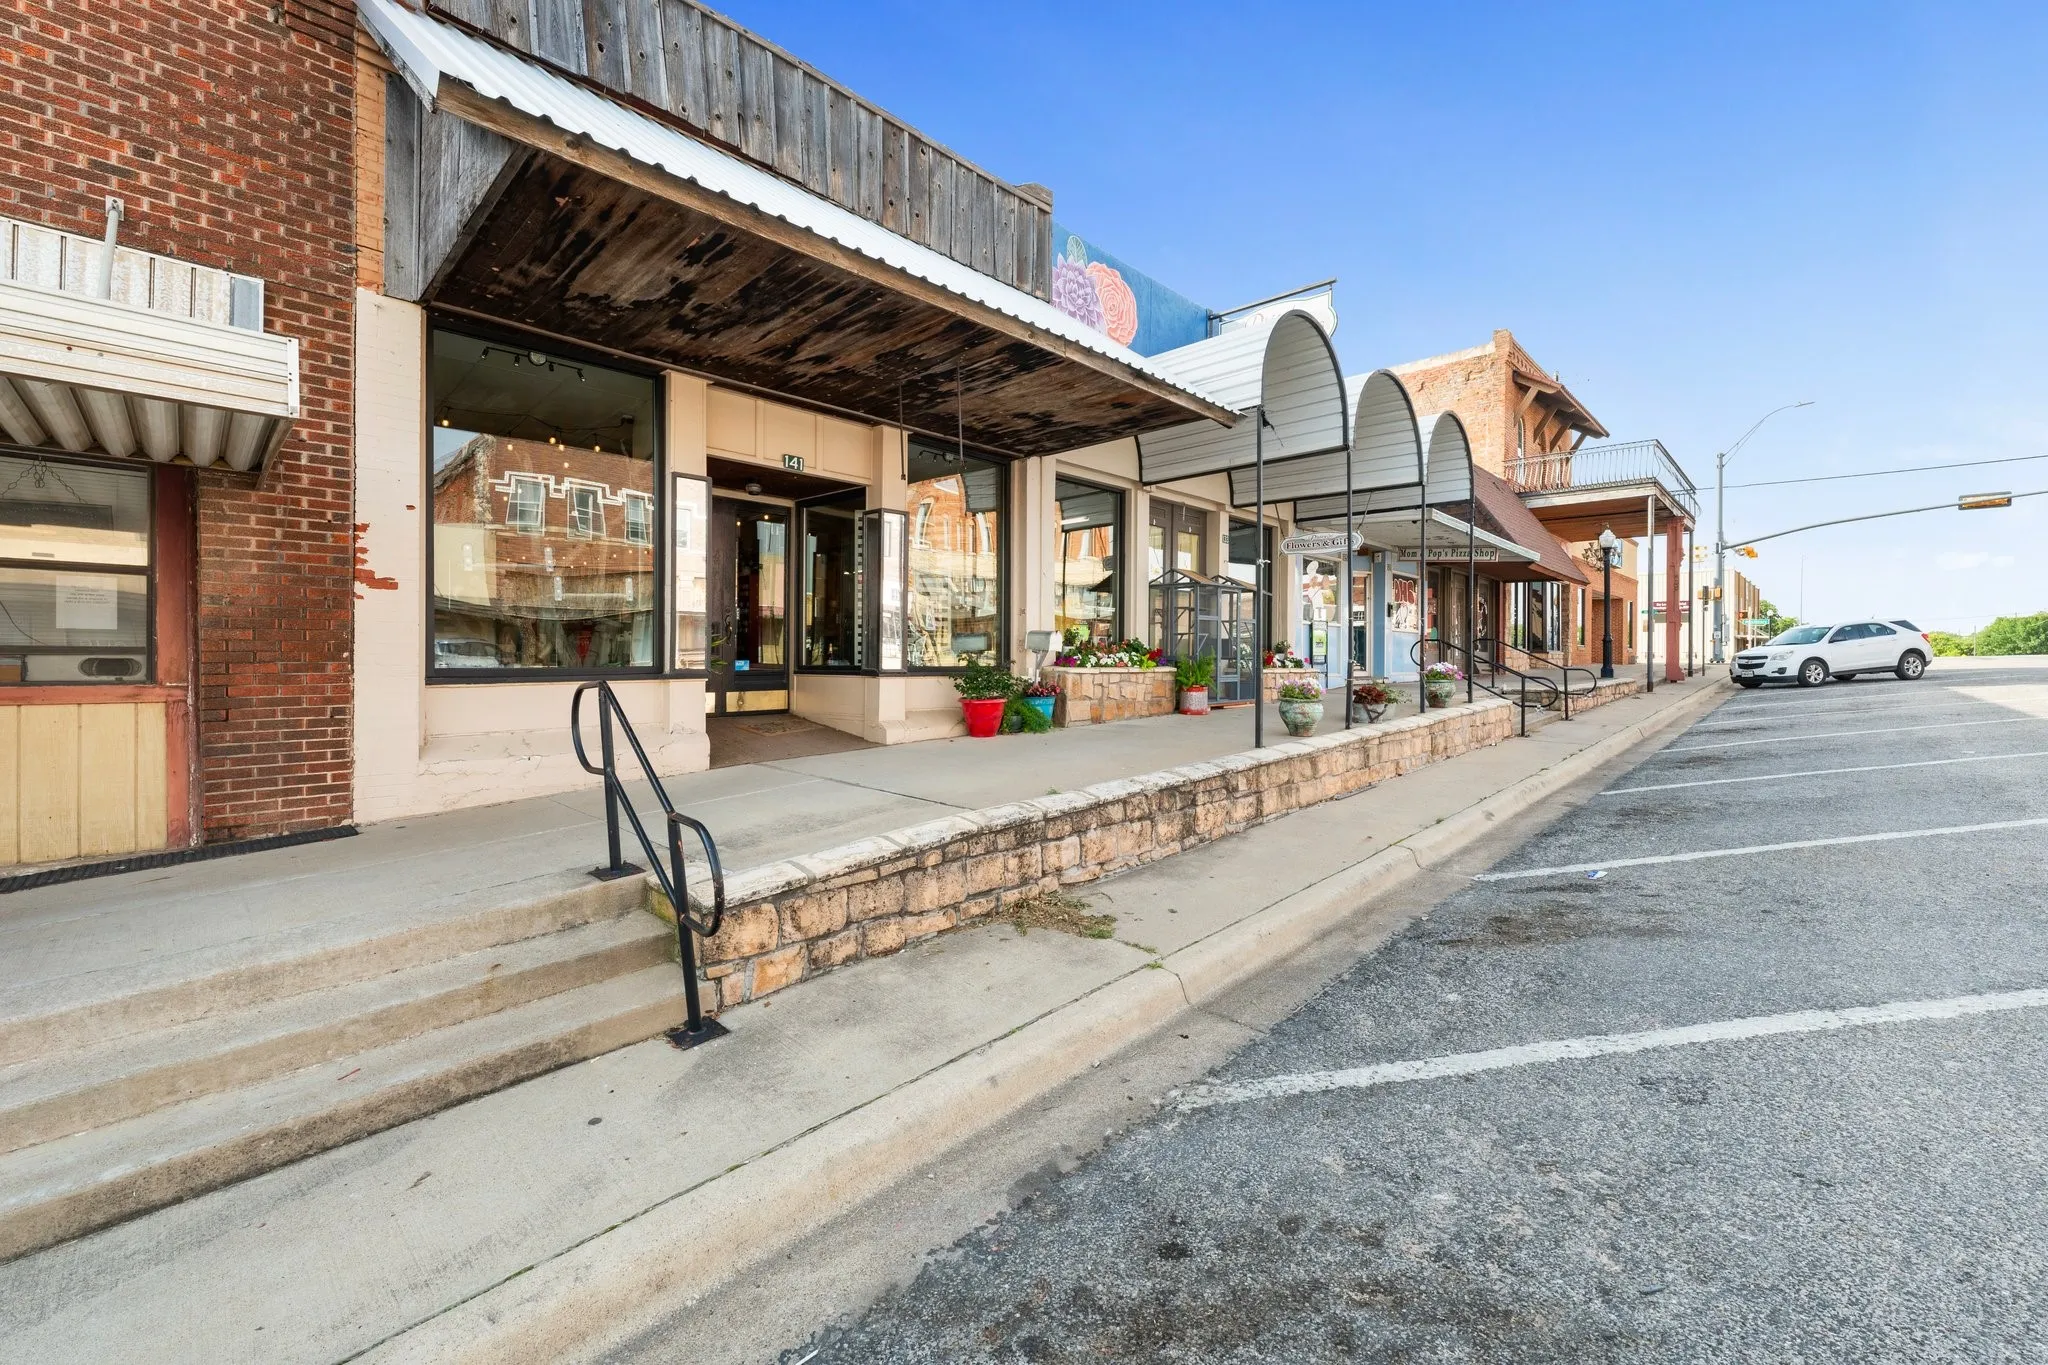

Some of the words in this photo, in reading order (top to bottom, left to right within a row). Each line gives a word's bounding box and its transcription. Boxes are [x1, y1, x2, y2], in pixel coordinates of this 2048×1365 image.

[784, 455, 804, 471] 141
[1286, 541, 1321, 550] Flowers
[1322, 539, 1331, 547] &
[1332, 538, 1355, 546] Gifs
[1400, 549, 1418, 558] Mom
[1427, 549, 1448, 560] Pop's
[1474, 548, 1495, 560] Shop
